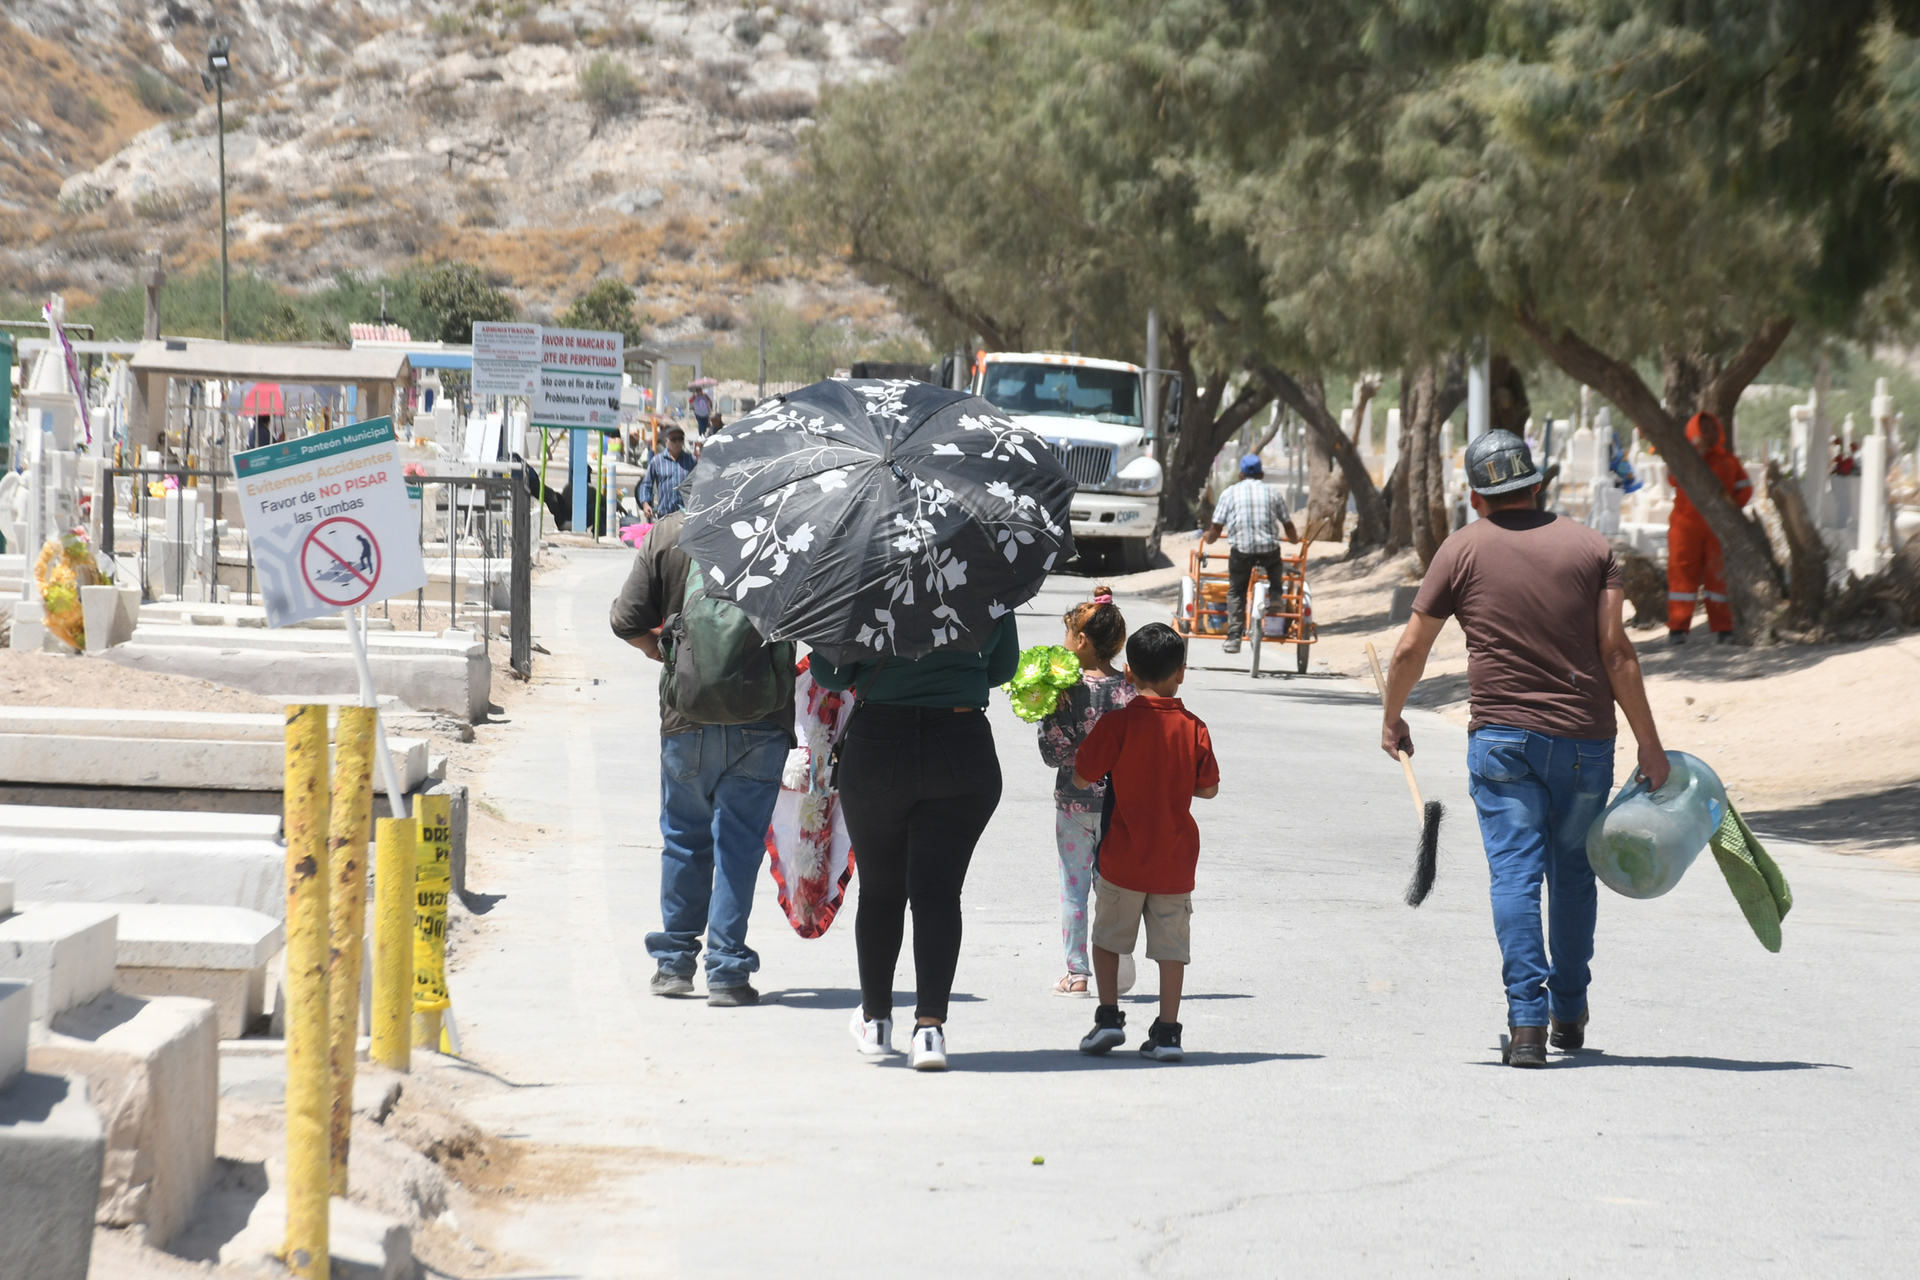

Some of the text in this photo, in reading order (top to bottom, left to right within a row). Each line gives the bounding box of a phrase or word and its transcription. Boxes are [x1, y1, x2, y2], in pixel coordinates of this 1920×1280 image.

[541, 334, 564, 347] FAVOR
[565, 336, 575, 348] DE
[576, 337, 605, 350] MARCAR
[606, 339, 616, 351] SU
[541, 351, 557, 364] OTE
[558, 353, 568, 365] DE
[569, 354, 617, 368] PERPETUIDAD
[554, 378, 567, 388] con
[568, 378, 575, 388] el
[576, 378, 585, 389] fin
[585, 379, 594, 390] de
[595, 379, 615, 391] Evitar
[544, 391, 606, 406] Problemas Futuros
[300, 425, 389, 456] Panteón Municipal
[246, 451, 393, 497] Evitemos Accidentes
[260, 470, 388, 514] Favor de NO PISAR
[294, 497, 364, 524] las Tumbas
